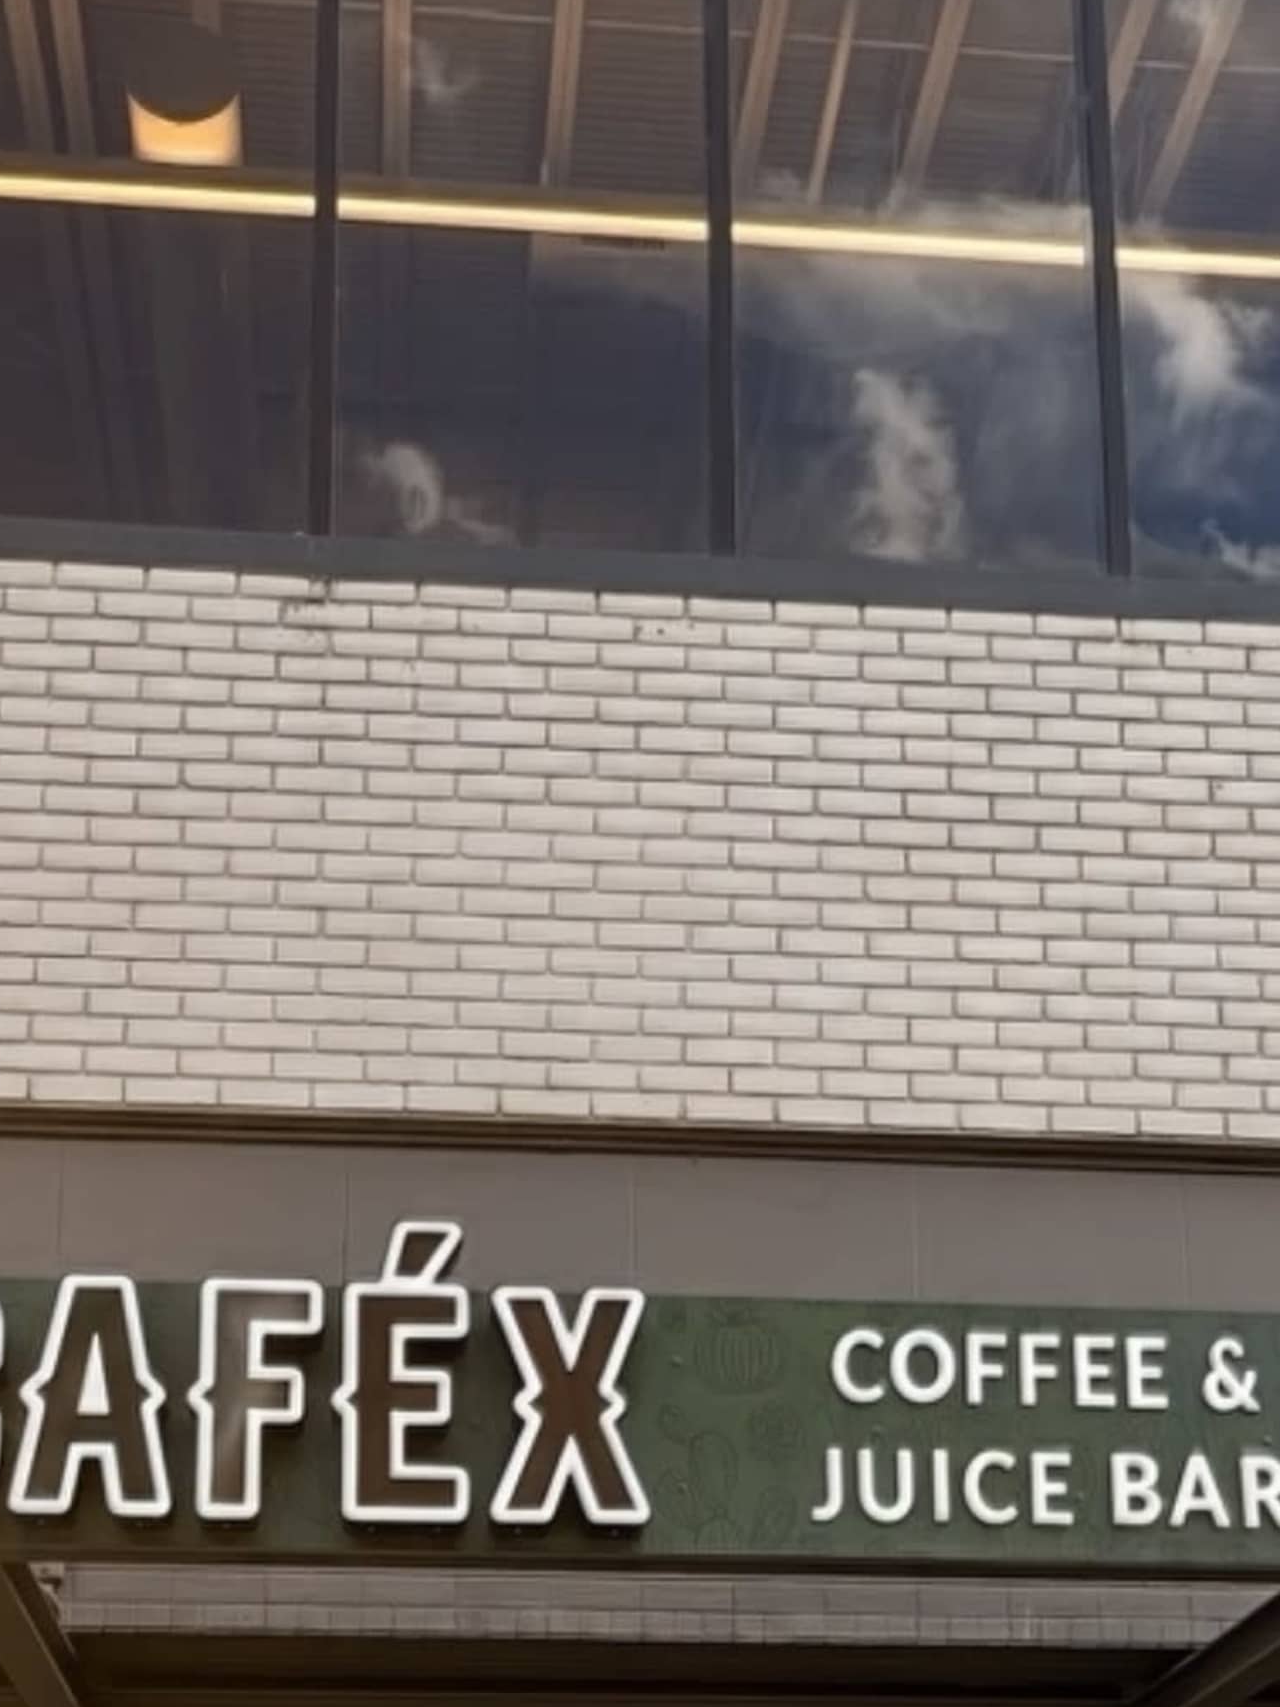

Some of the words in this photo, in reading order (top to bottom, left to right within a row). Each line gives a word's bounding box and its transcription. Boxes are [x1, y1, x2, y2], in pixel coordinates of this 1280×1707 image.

[830, 1328, 1169, 1409] COFFEE
[1202, 1337, 1261, 1412] &
[811, 1447, 1074, 1526] JUICE
